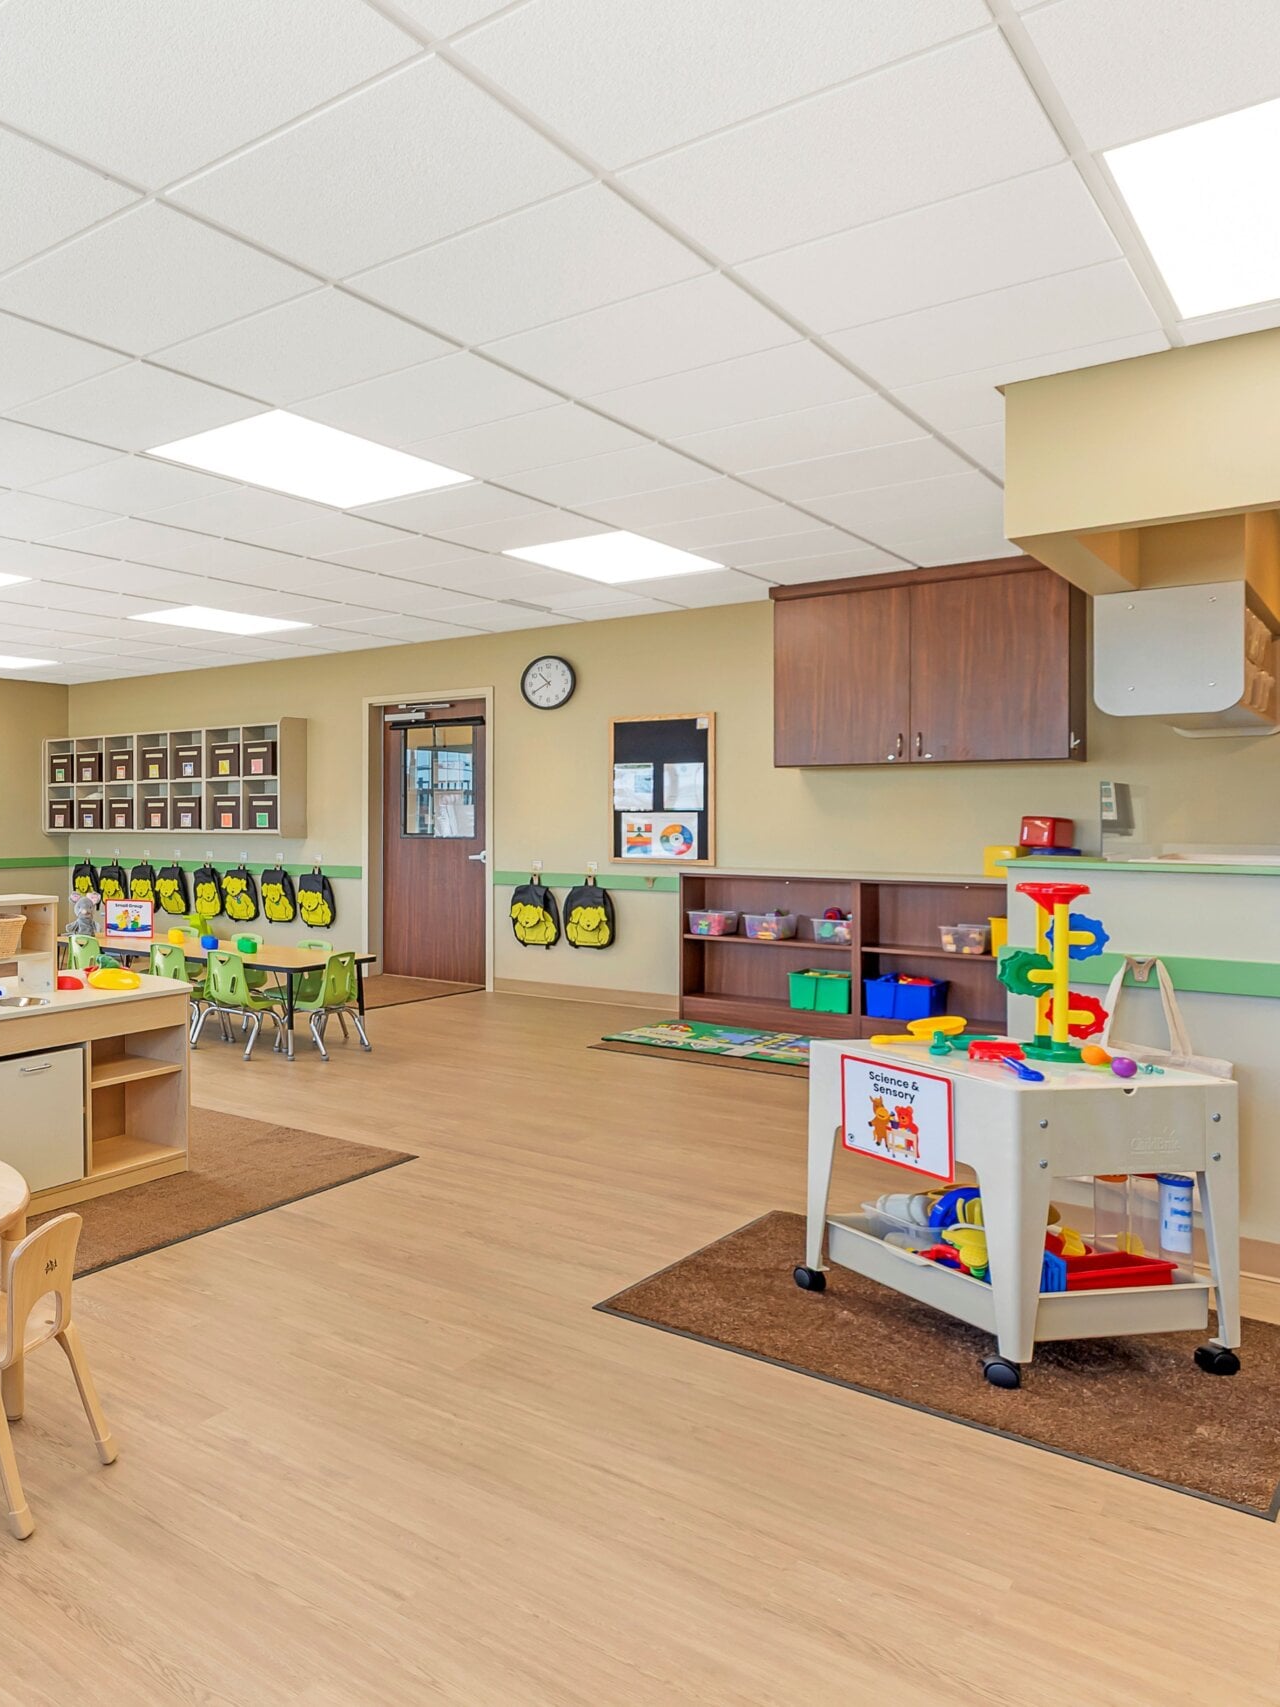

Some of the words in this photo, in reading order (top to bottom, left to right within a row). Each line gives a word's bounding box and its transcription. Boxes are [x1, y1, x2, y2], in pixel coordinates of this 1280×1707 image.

[869, 1071, 909, 1089] Science
[911, 1081, 920, 1092] &
[873, 1083, 915, 1104] Sensory
